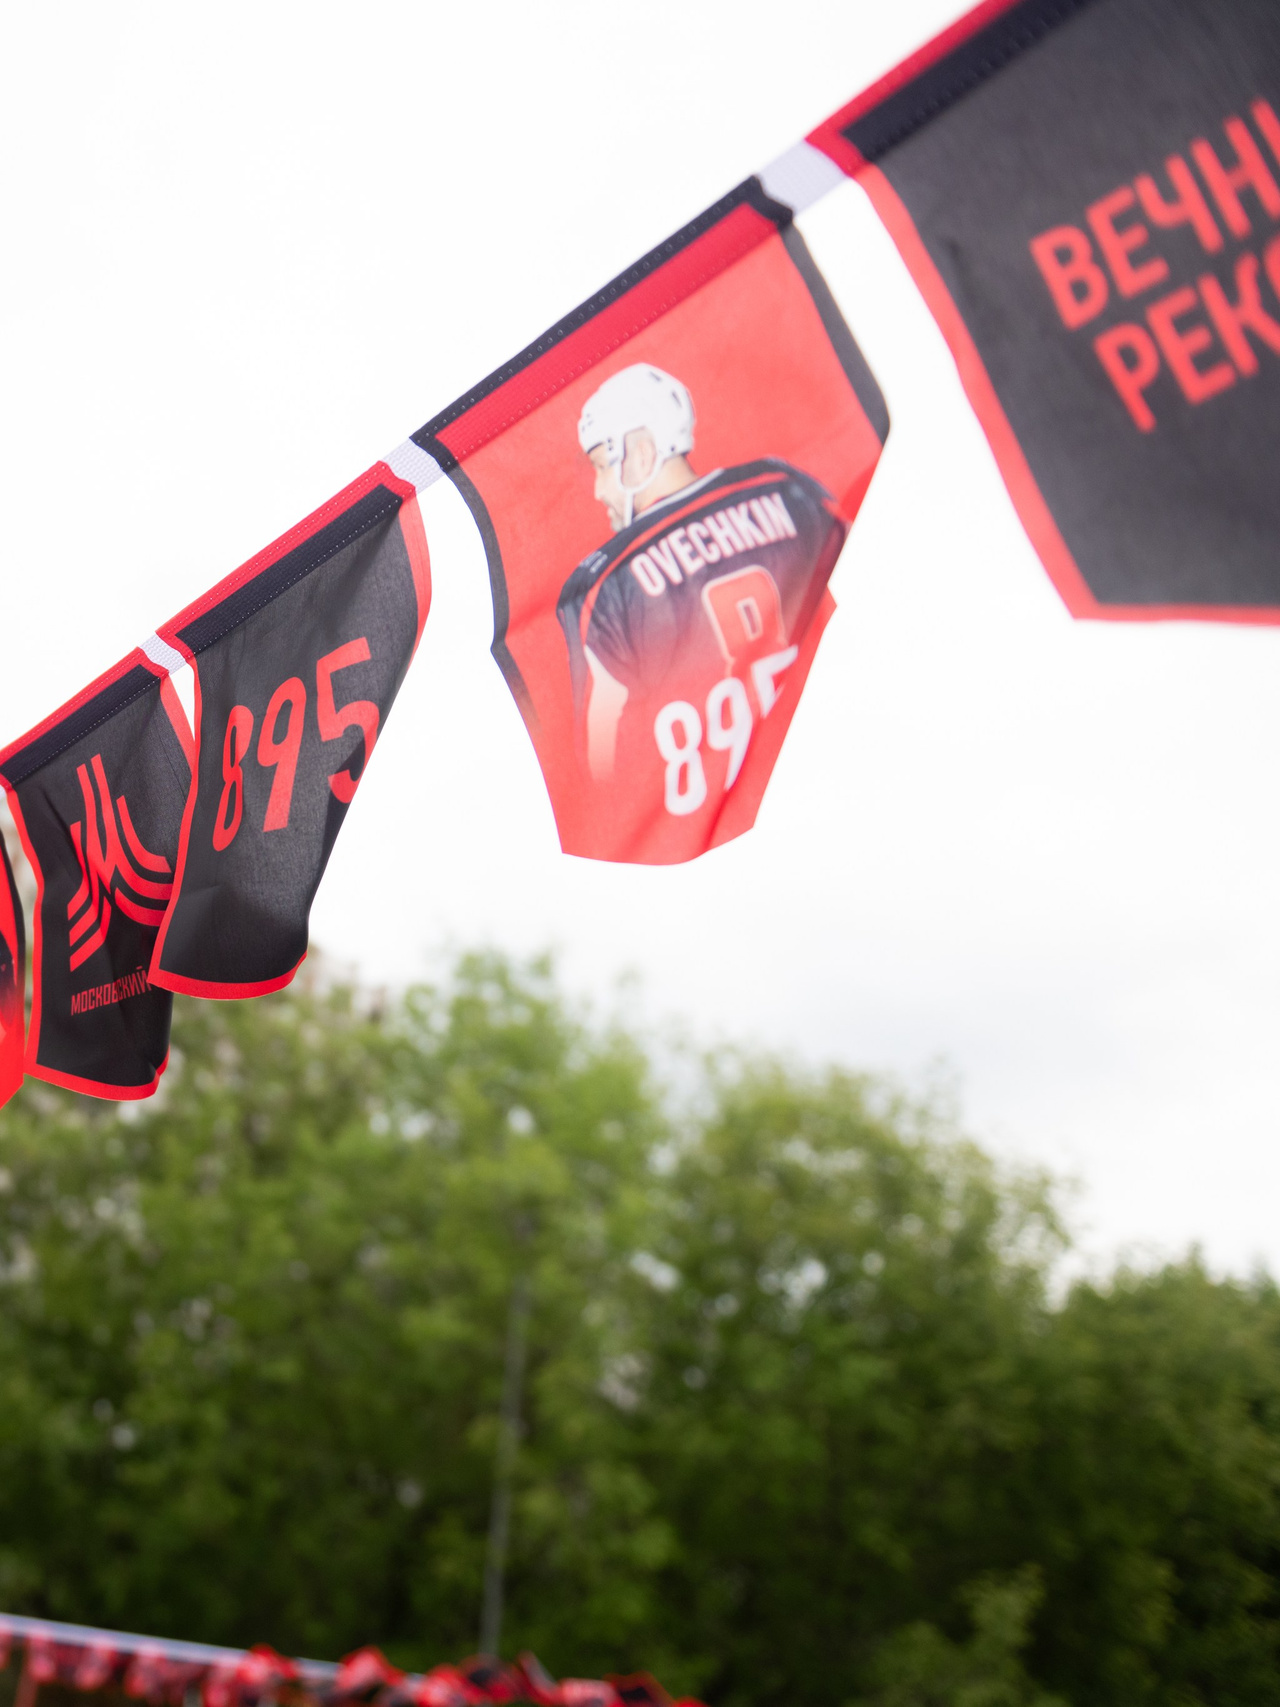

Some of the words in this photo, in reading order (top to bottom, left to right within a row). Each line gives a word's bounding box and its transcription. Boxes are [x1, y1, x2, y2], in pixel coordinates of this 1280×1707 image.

[1030, 98, 1280, 330] ВЕЧН
[1093, 237, 1280, 434] РЕК
[631, 493, 797, 596] OVECHKIN
[213, 637, 379, 851] 895
